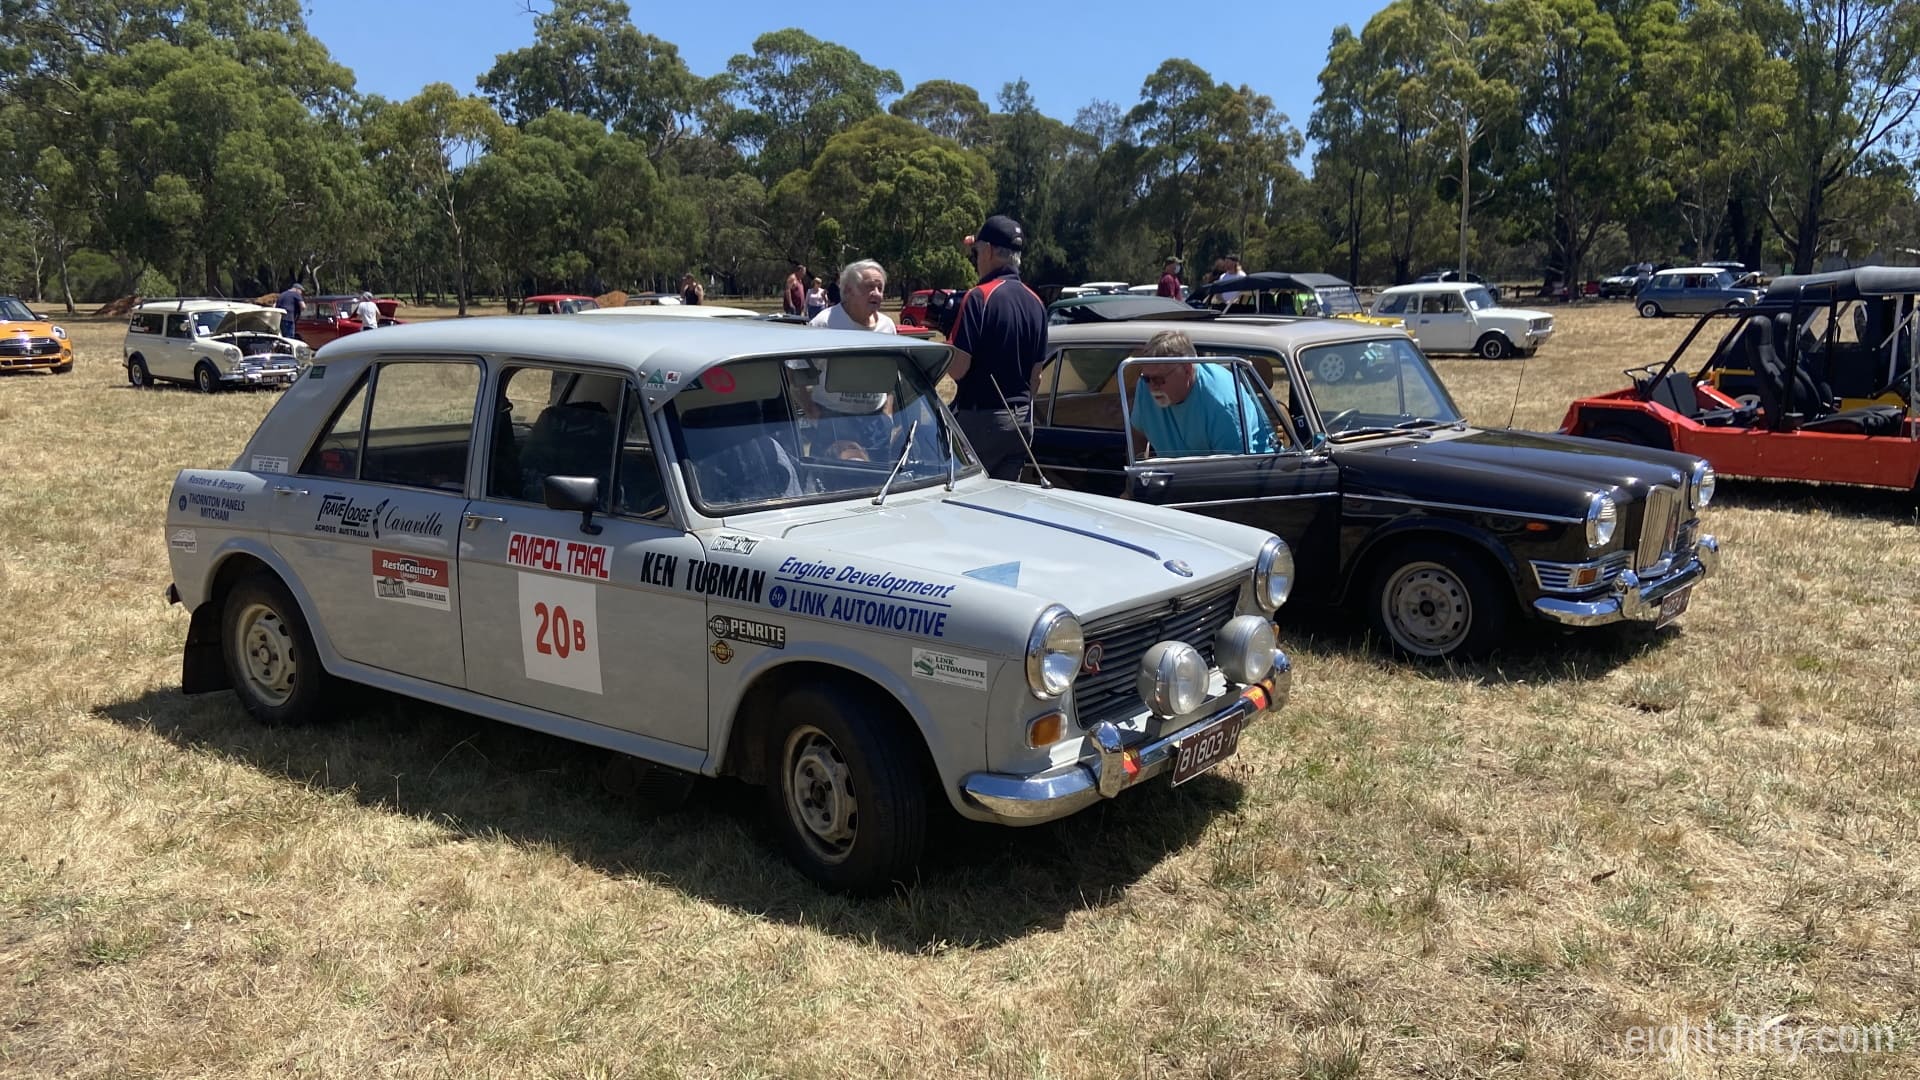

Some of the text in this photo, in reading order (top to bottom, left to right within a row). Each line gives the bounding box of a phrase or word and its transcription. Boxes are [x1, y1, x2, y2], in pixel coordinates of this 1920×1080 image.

[189, 493, 221, 507] THORNTON
[222, 498, 246, 511] PANELS
[200, 508, 230, 521] MITCHAM
[384, 506, 443, 536] Caravilla
[314, 524, 370, 538] ACROSS AUSTRALIA
[509, 534, 609, 578] AMPOL TRIAL
[382, 559, 438, 578] RestoCountry
[640, 551, 766, 603] KEN TUBMAN
[778, 556, 957, 599] Engine Development
[771, 589, 947, 637] by LINK AUTOMOTIVE
[730, 619, 785, 642] PENRITE
[935, 656, 954, 665] LINK
[935, 663, 985, 678] AUTOMOTIVE
